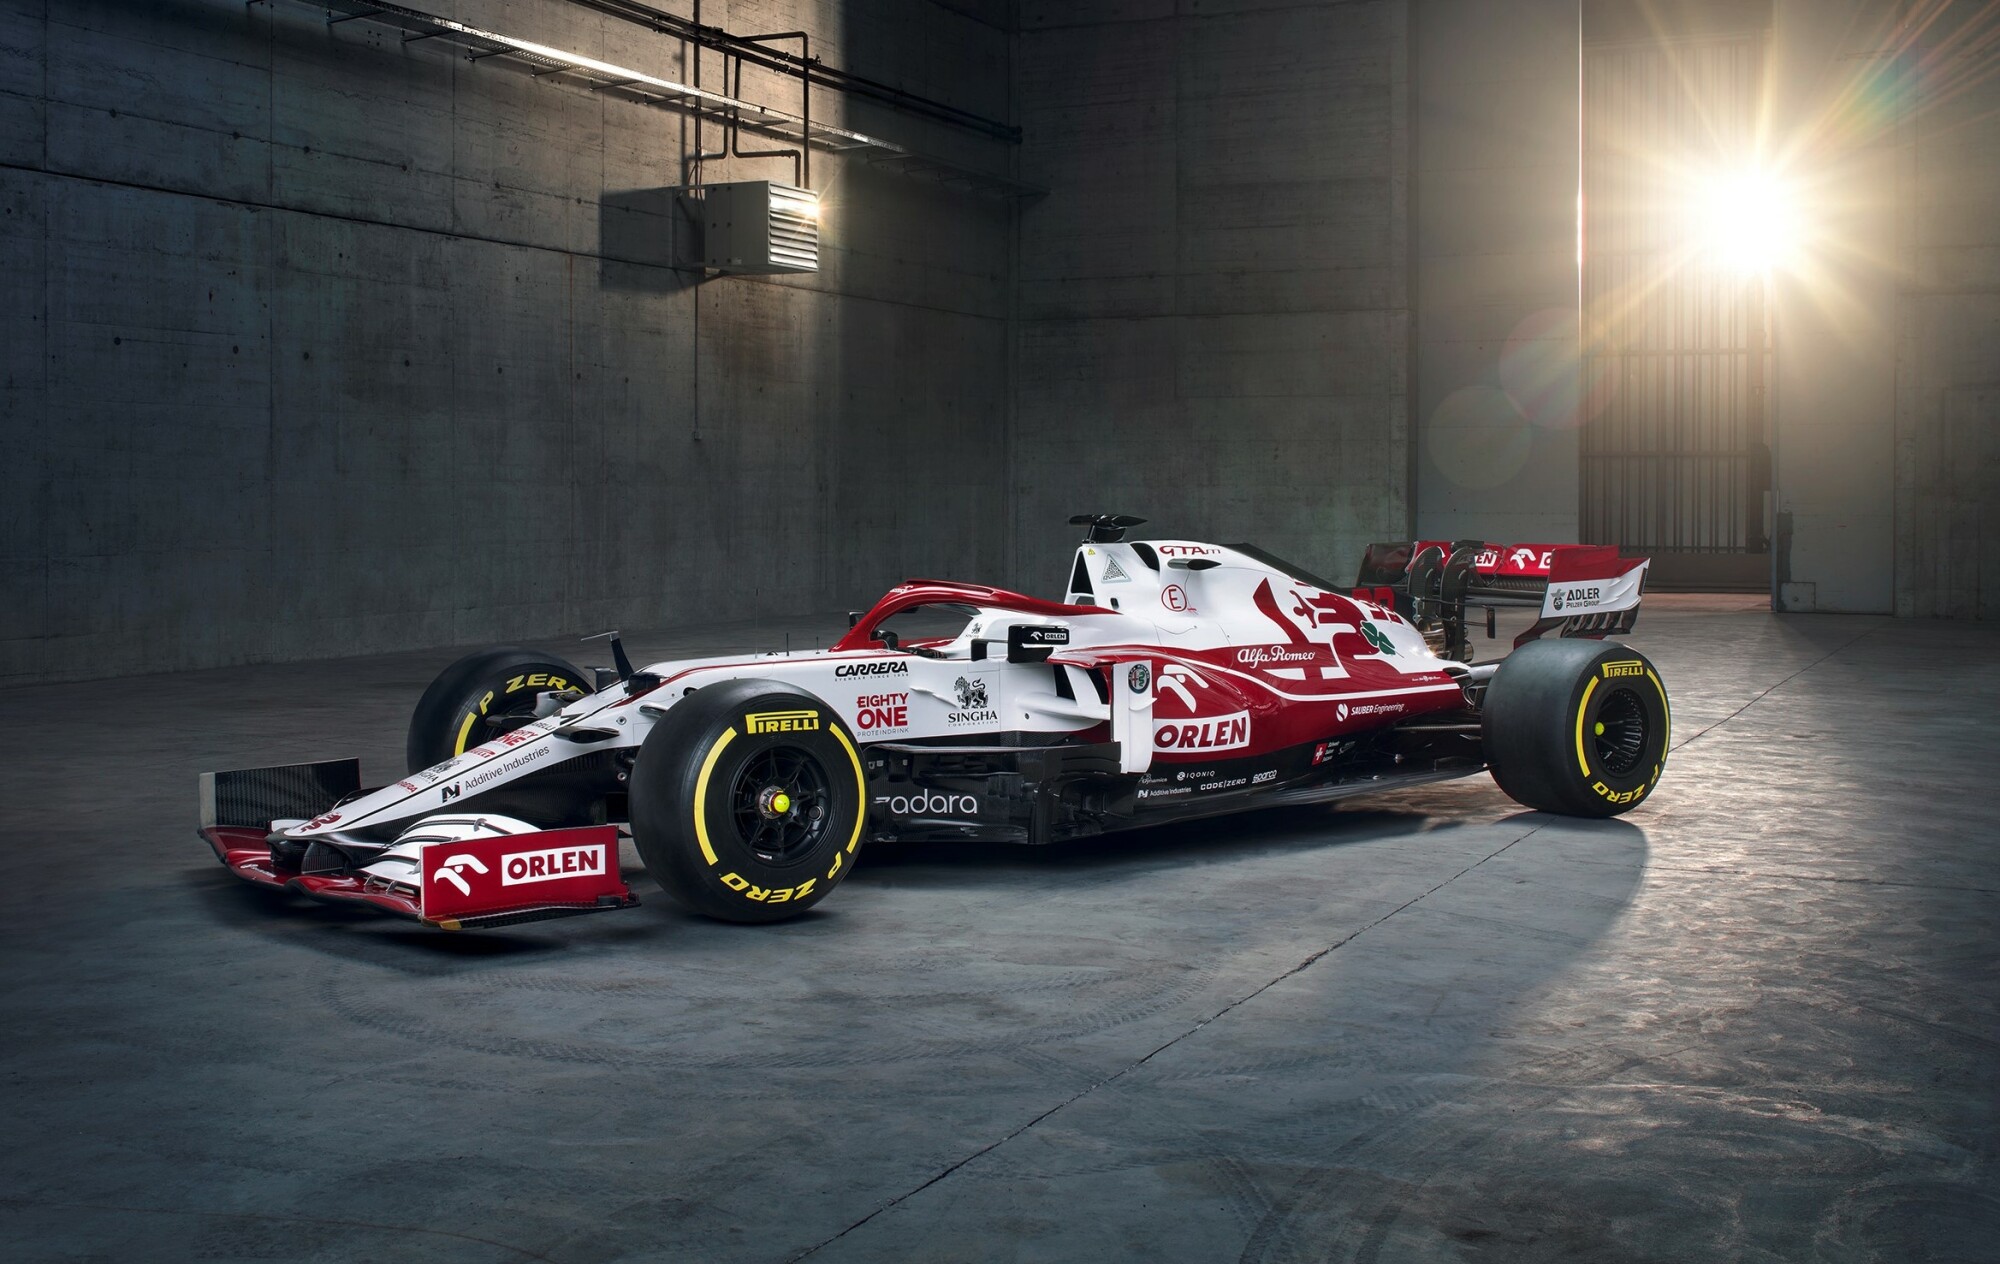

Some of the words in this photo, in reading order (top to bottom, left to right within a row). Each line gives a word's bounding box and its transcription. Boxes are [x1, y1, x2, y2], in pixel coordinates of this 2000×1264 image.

[1566, 587, 1600, 601] ADLER
[1237, 648, 1271, 669] Alfa
[1271, 645, 1316, 661] Romeo
[835, 661, 908, 677] CARRERA
[1602, 661, 1644, 678] PIRELLI
[480, 691, 494, 715] P
[856, 692, 909, 708] EIGHTY
[1351, 705, 1374, 716] SAUBER
[1374, 703, 1405, 715] Engineering
[745, 710, 820, 734] PIRELLI
[857, 706, 908, 729] ONE
[948, 710, 998, 723] SINGHA
[857, 728, 909, 737] PROTEINDRINK
[1154, 716, 1247, 749] ORLEN
[465, 767, 503, 790] Additive
[504, 746, 550, 773] Industries
[1186, 770, 1215, 780] IQONIQ
[1252, 770, 1278, 783] sparco
[1651, 764, 1659, 785] P
[1150, 789, 1169, 797] Additive
[1169, 787, 1192, 795] Industries
[1592, 781, 1645, 804] ZERO
[507, 850, 598, 880] ORLEN
[828, 851, 842, 879] P
[720, 872, 817, 904] ZERO
